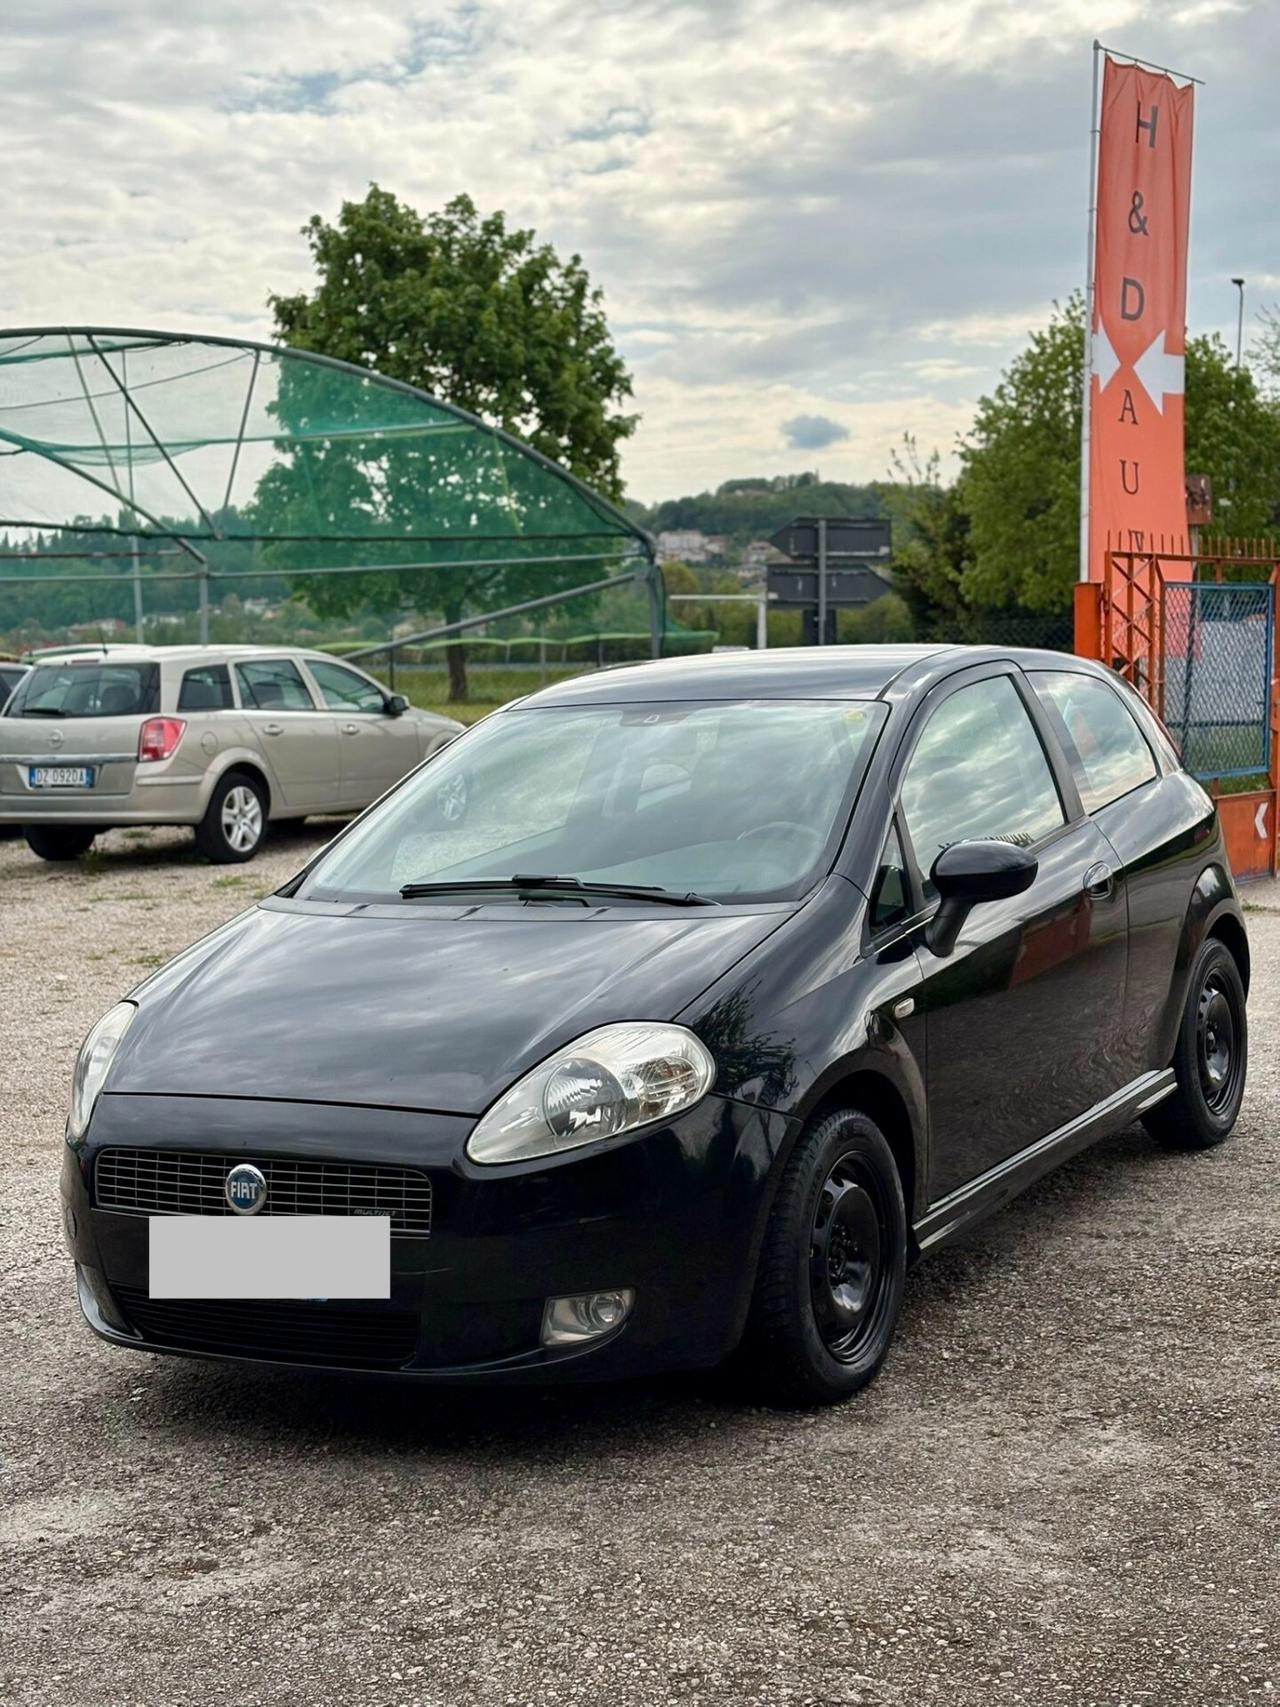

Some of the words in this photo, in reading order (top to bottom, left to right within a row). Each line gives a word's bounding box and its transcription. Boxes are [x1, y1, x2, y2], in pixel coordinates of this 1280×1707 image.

[1135, 101, 1158, 148] H
[1128, 190, 1149, 236] &
[1120, 277, 1145, 321] D
[230, 1181, 257, 1199] FIAT
